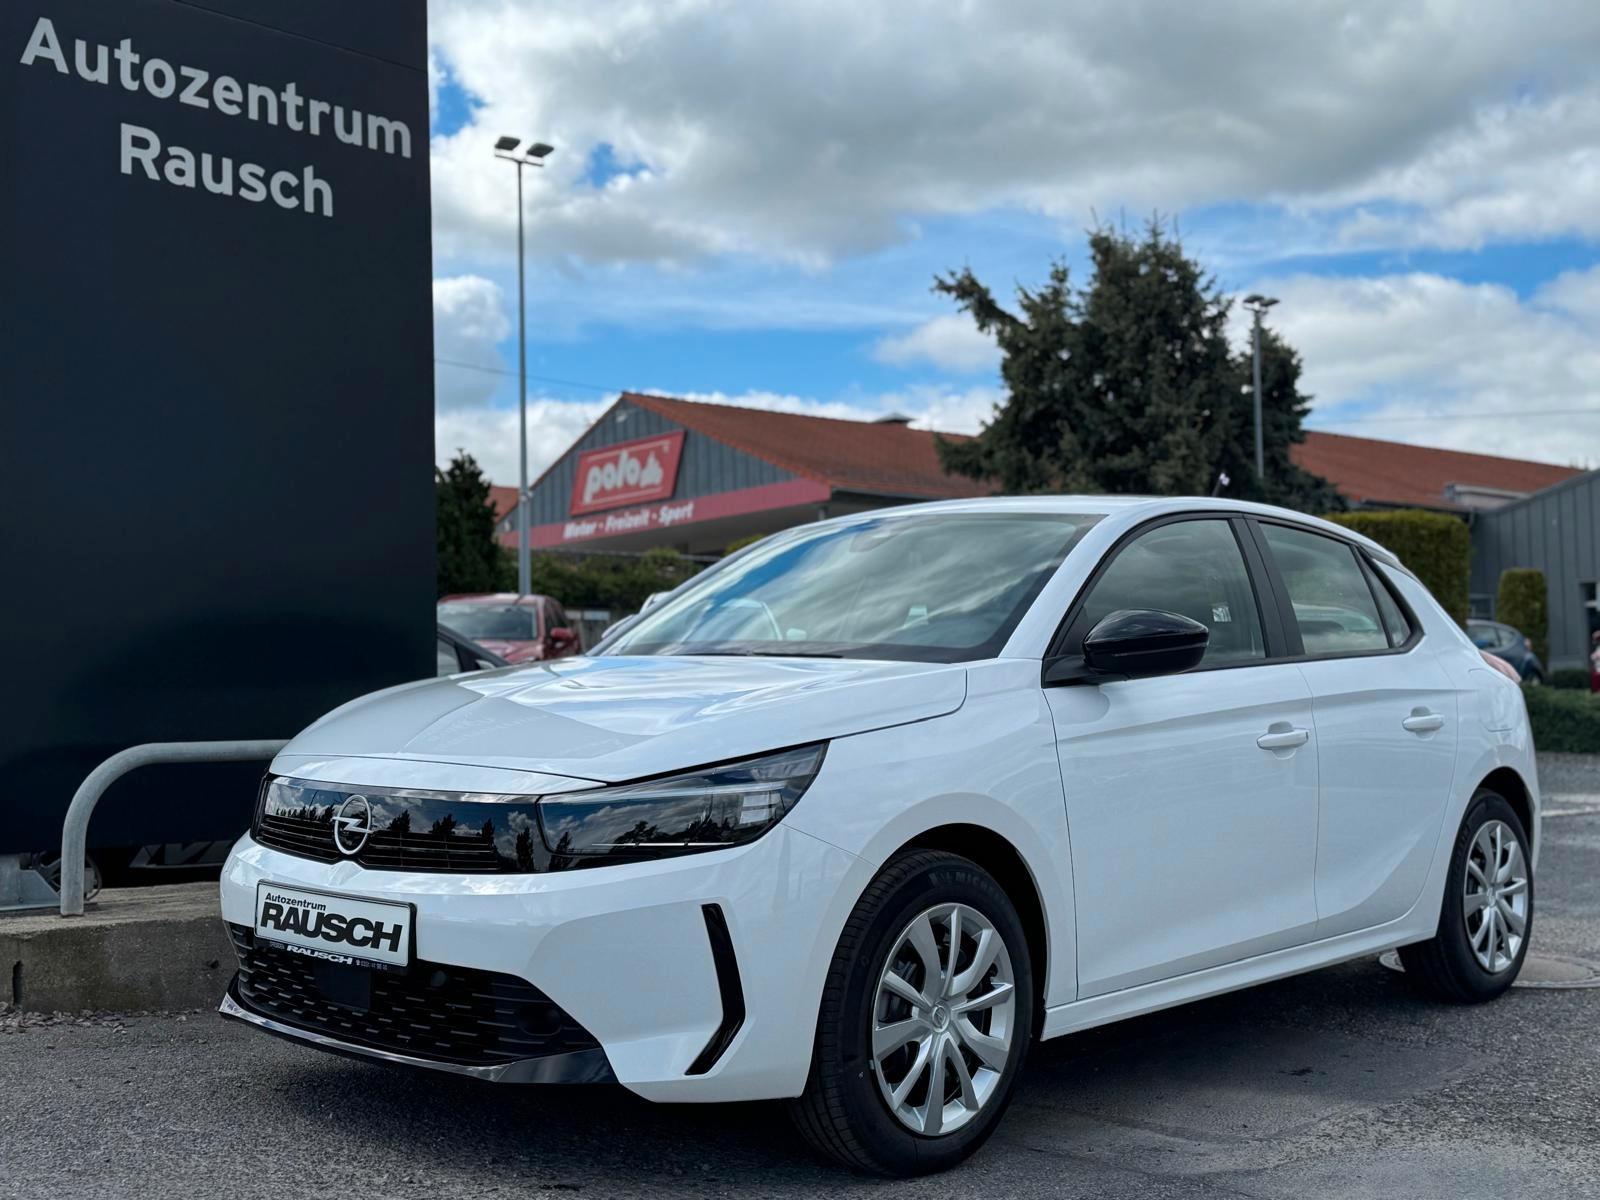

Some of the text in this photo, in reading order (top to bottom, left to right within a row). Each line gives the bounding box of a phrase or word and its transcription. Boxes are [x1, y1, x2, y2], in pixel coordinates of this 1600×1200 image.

[20, 17, 411, 158] Autozentrum
[120, 123, 333, 217] Rausch
[583, 451, 641, 503] polo
[605, 509, 649, 531] Freizeit
[659, 502, 694, 526] Sport
[265, 892, 327, 911] Autozentrum
[260, 902, 403, 952] RAUSCH
[286, 945, 353, 965] RAUSCH
